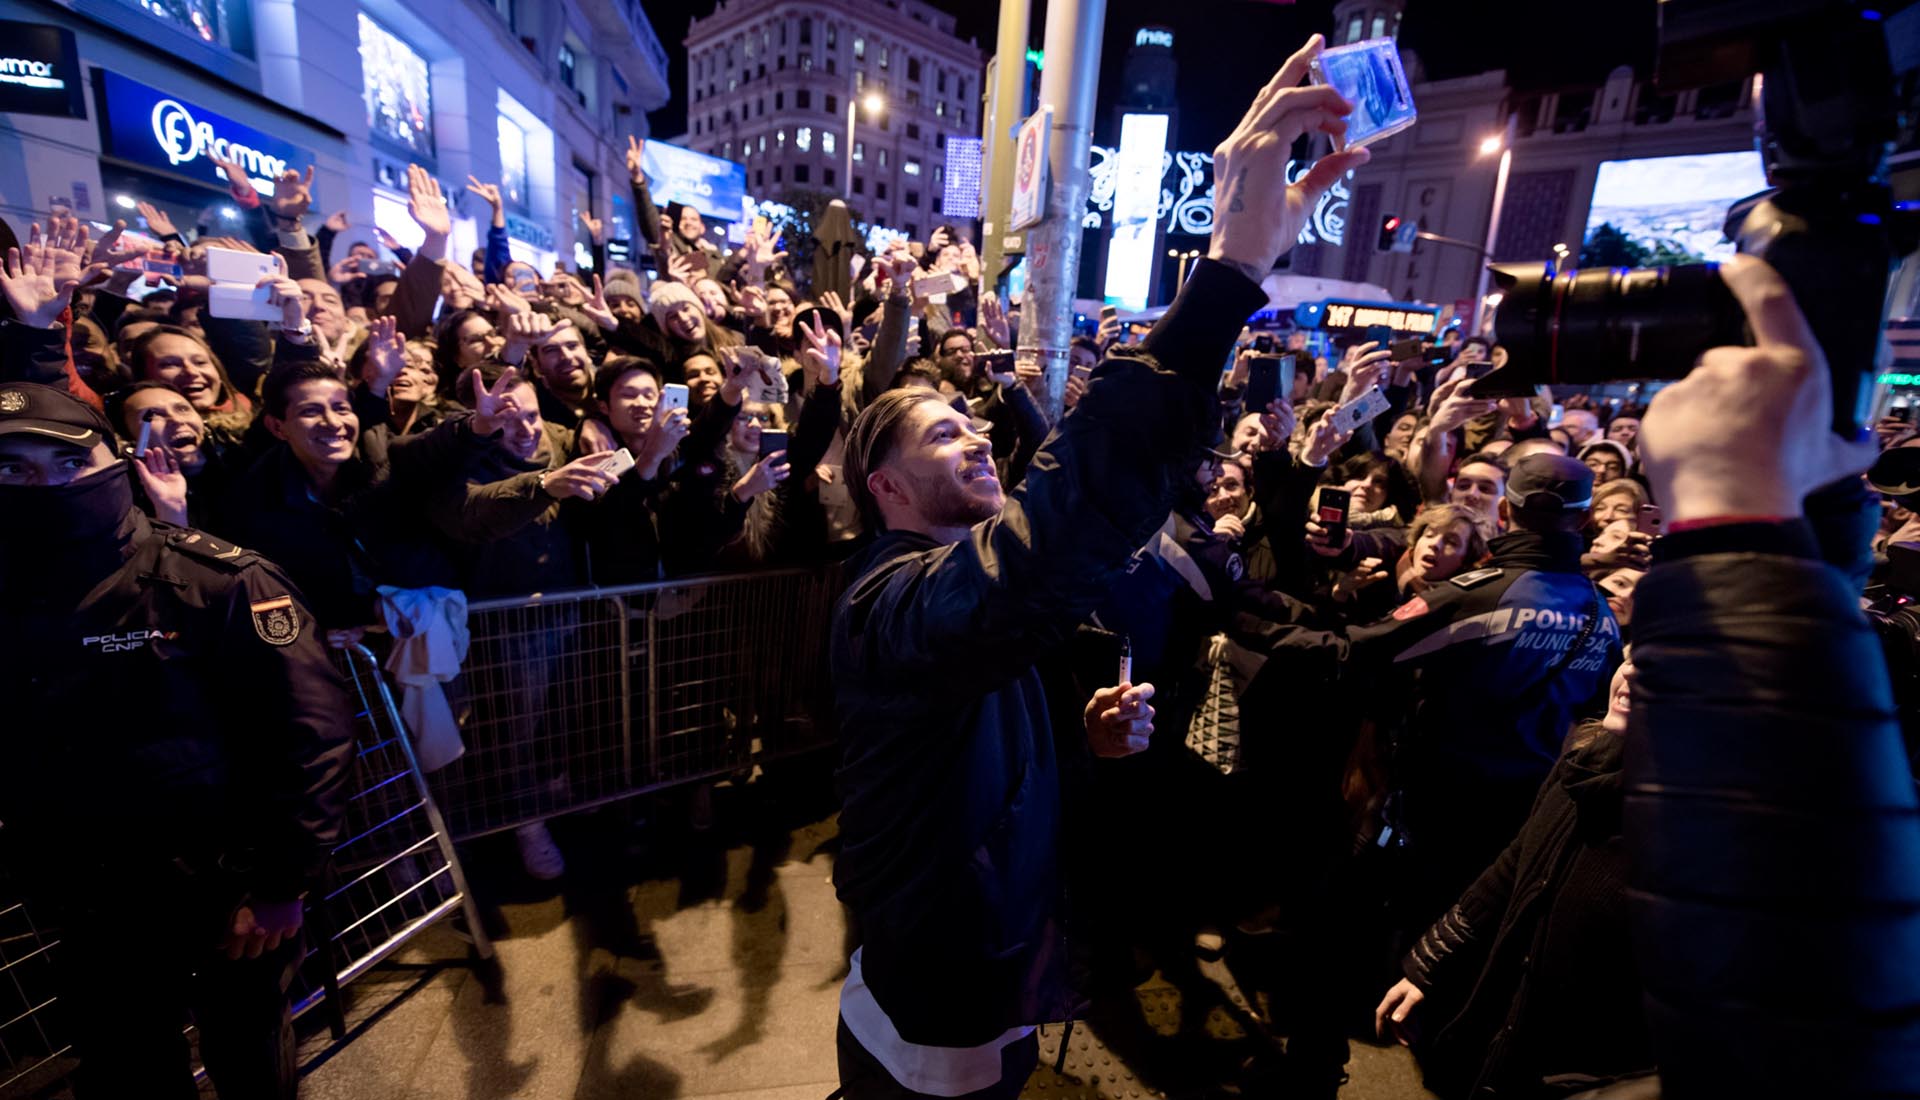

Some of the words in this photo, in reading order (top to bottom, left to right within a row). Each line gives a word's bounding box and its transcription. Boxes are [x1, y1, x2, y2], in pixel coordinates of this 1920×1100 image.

[1136, 28, 1172, 47] fnac
[1513, 608, 1613, 635] POLICIA
[83, 630, 164, 646] POLICIA
[102, 641, 144, 653] CNP
[1514, 632, 1612, 653] MUNICPAL
[1545, 653, 1605, 671] Mdrid
